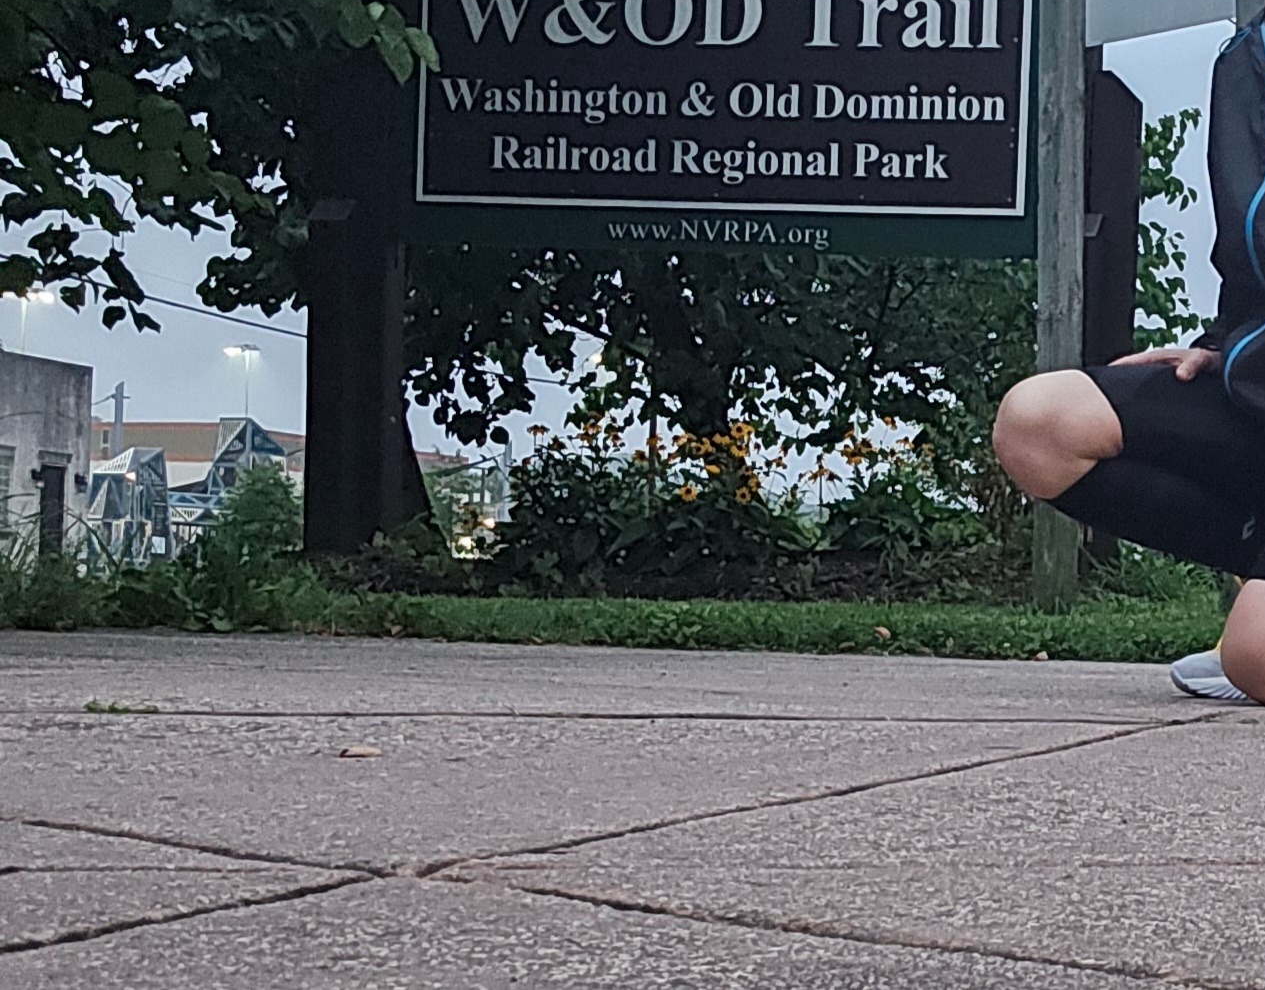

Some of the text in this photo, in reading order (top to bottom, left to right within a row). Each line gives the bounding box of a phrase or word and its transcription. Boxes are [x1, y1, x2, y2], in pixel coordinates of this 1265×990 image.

[440, 77, 1006, 124] Washington & Old Dominion
[490, 135, 949, 184] Railroad Regional Park
[608, 219, 830, 251] www.NVRPA.org
